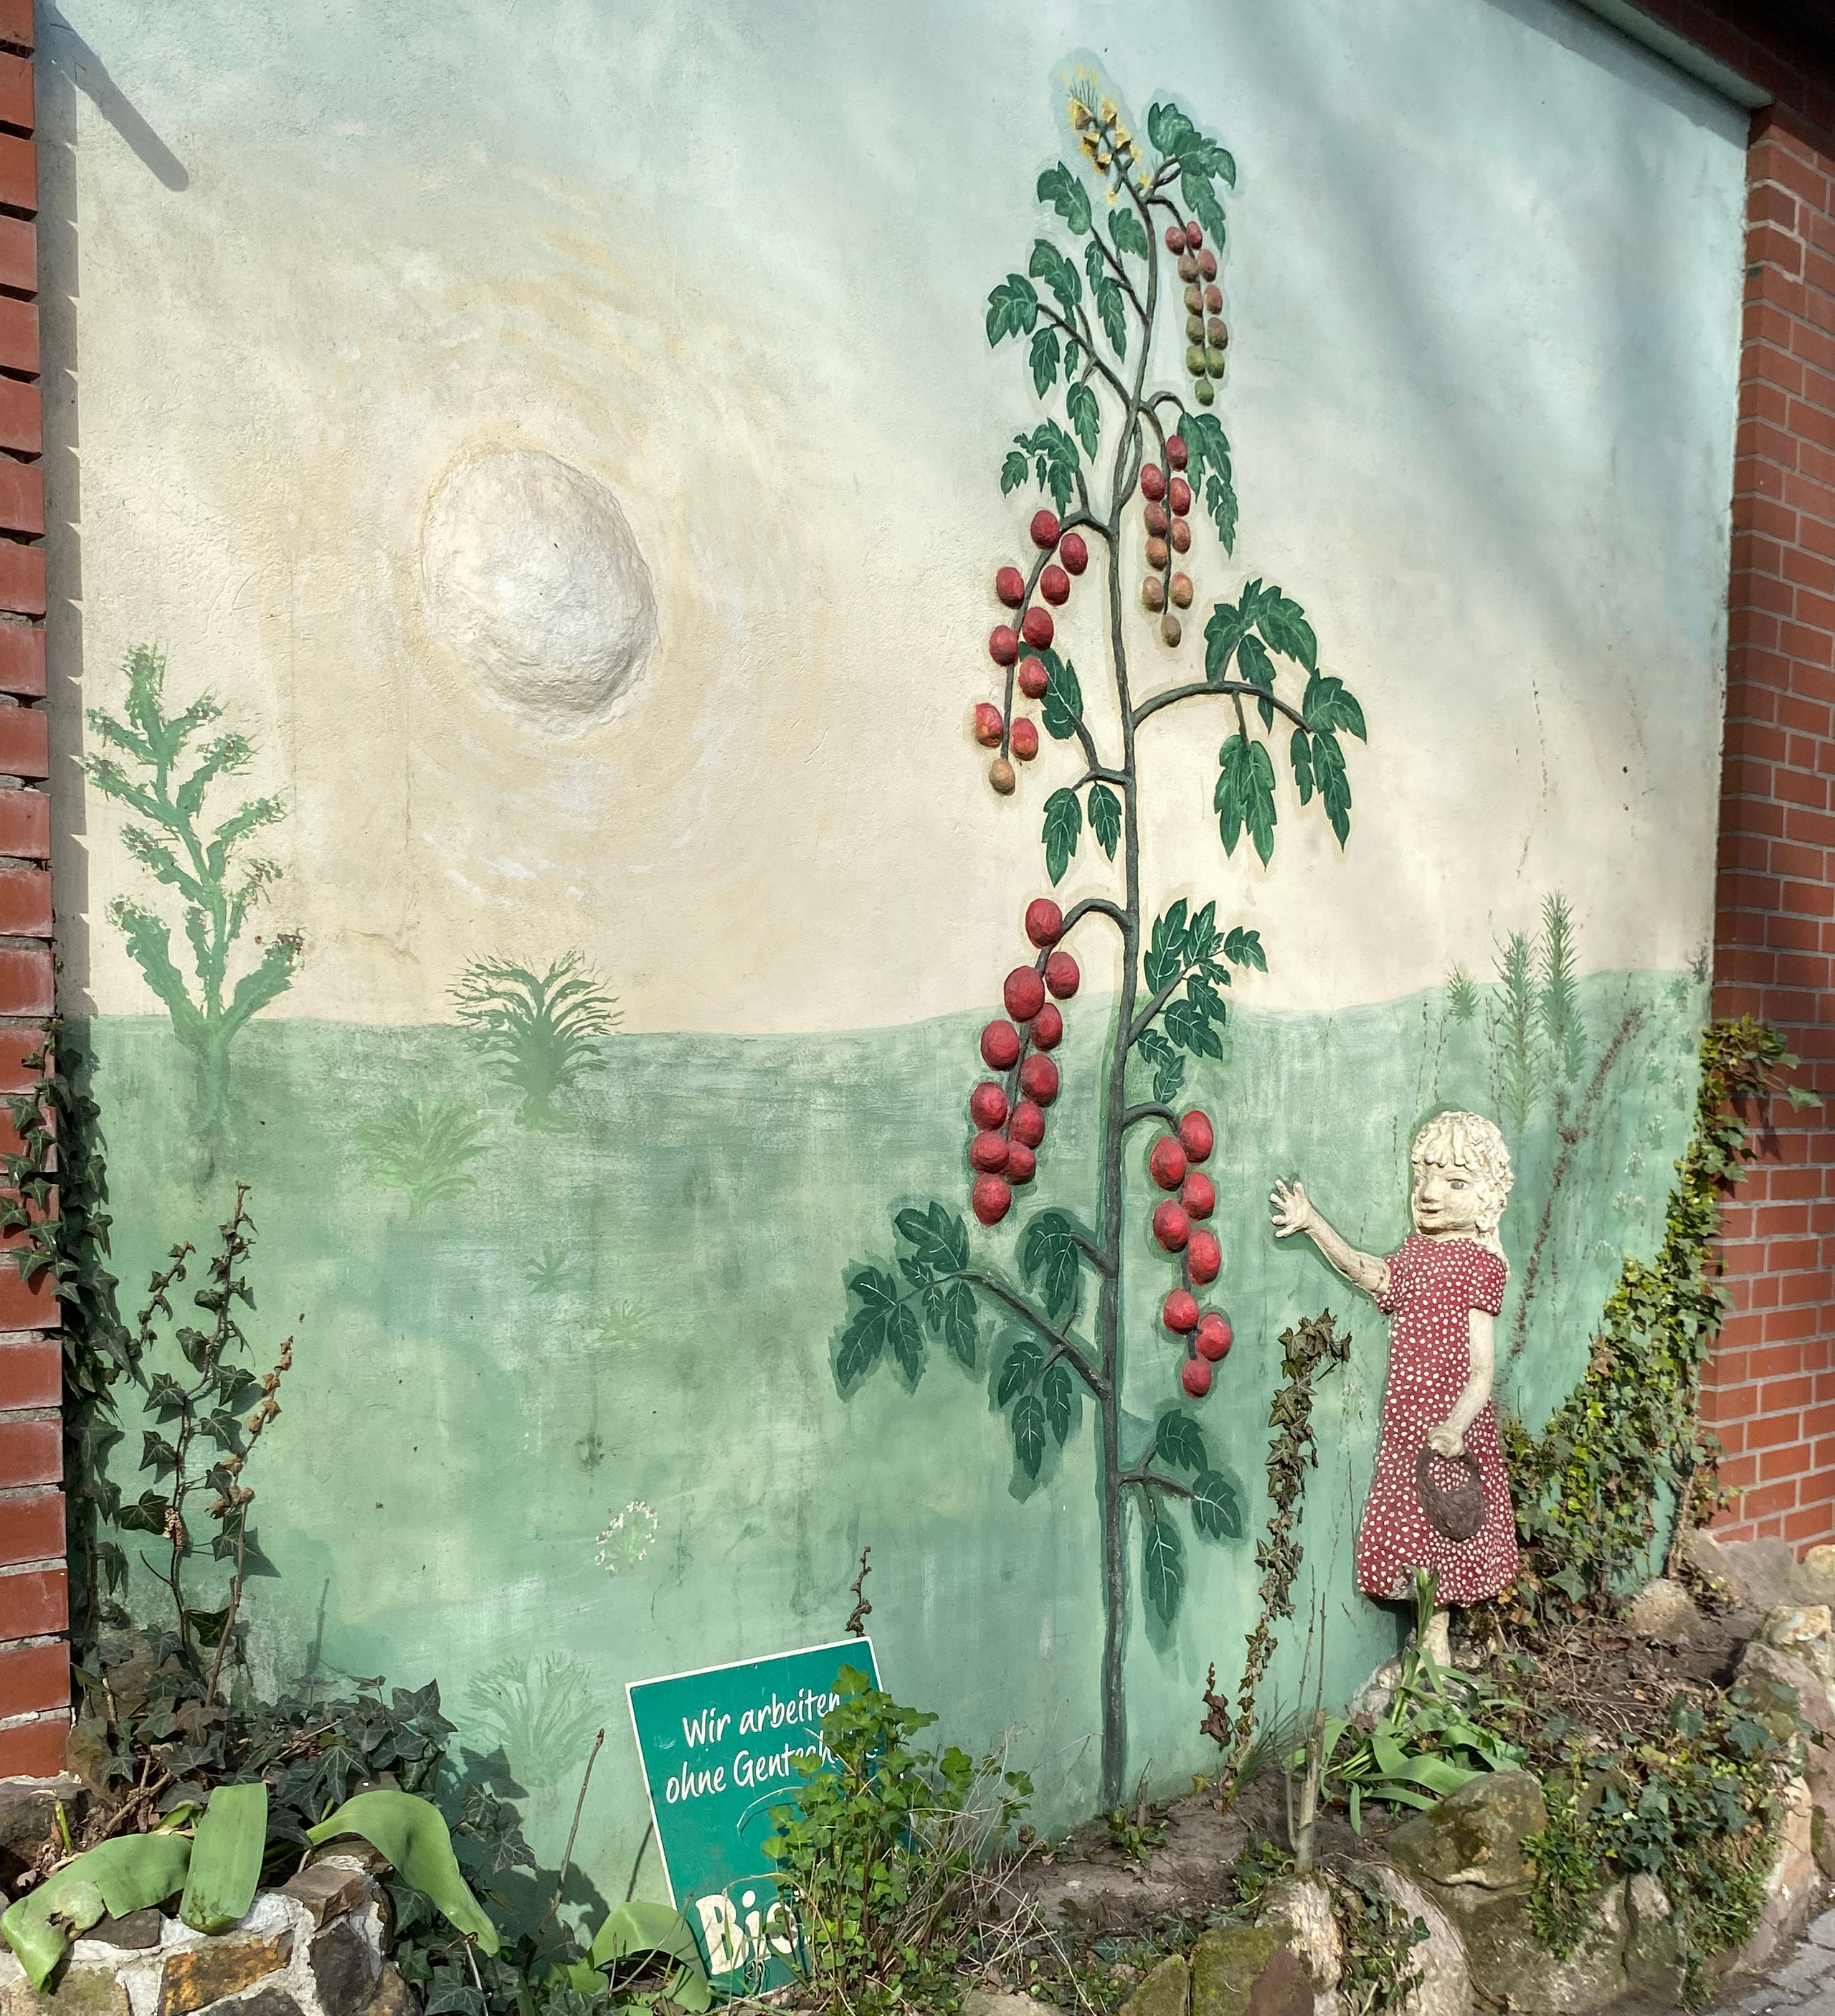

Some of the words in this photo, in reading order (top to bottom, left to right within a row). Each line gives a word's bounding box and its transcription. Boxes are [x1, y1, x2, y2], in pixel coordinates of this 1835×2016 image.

[682, 1707, 731, 1748] Wir
[739, 1688, 840, 1736] arbeiten
[665, 1761, 727, 1804] ohne
